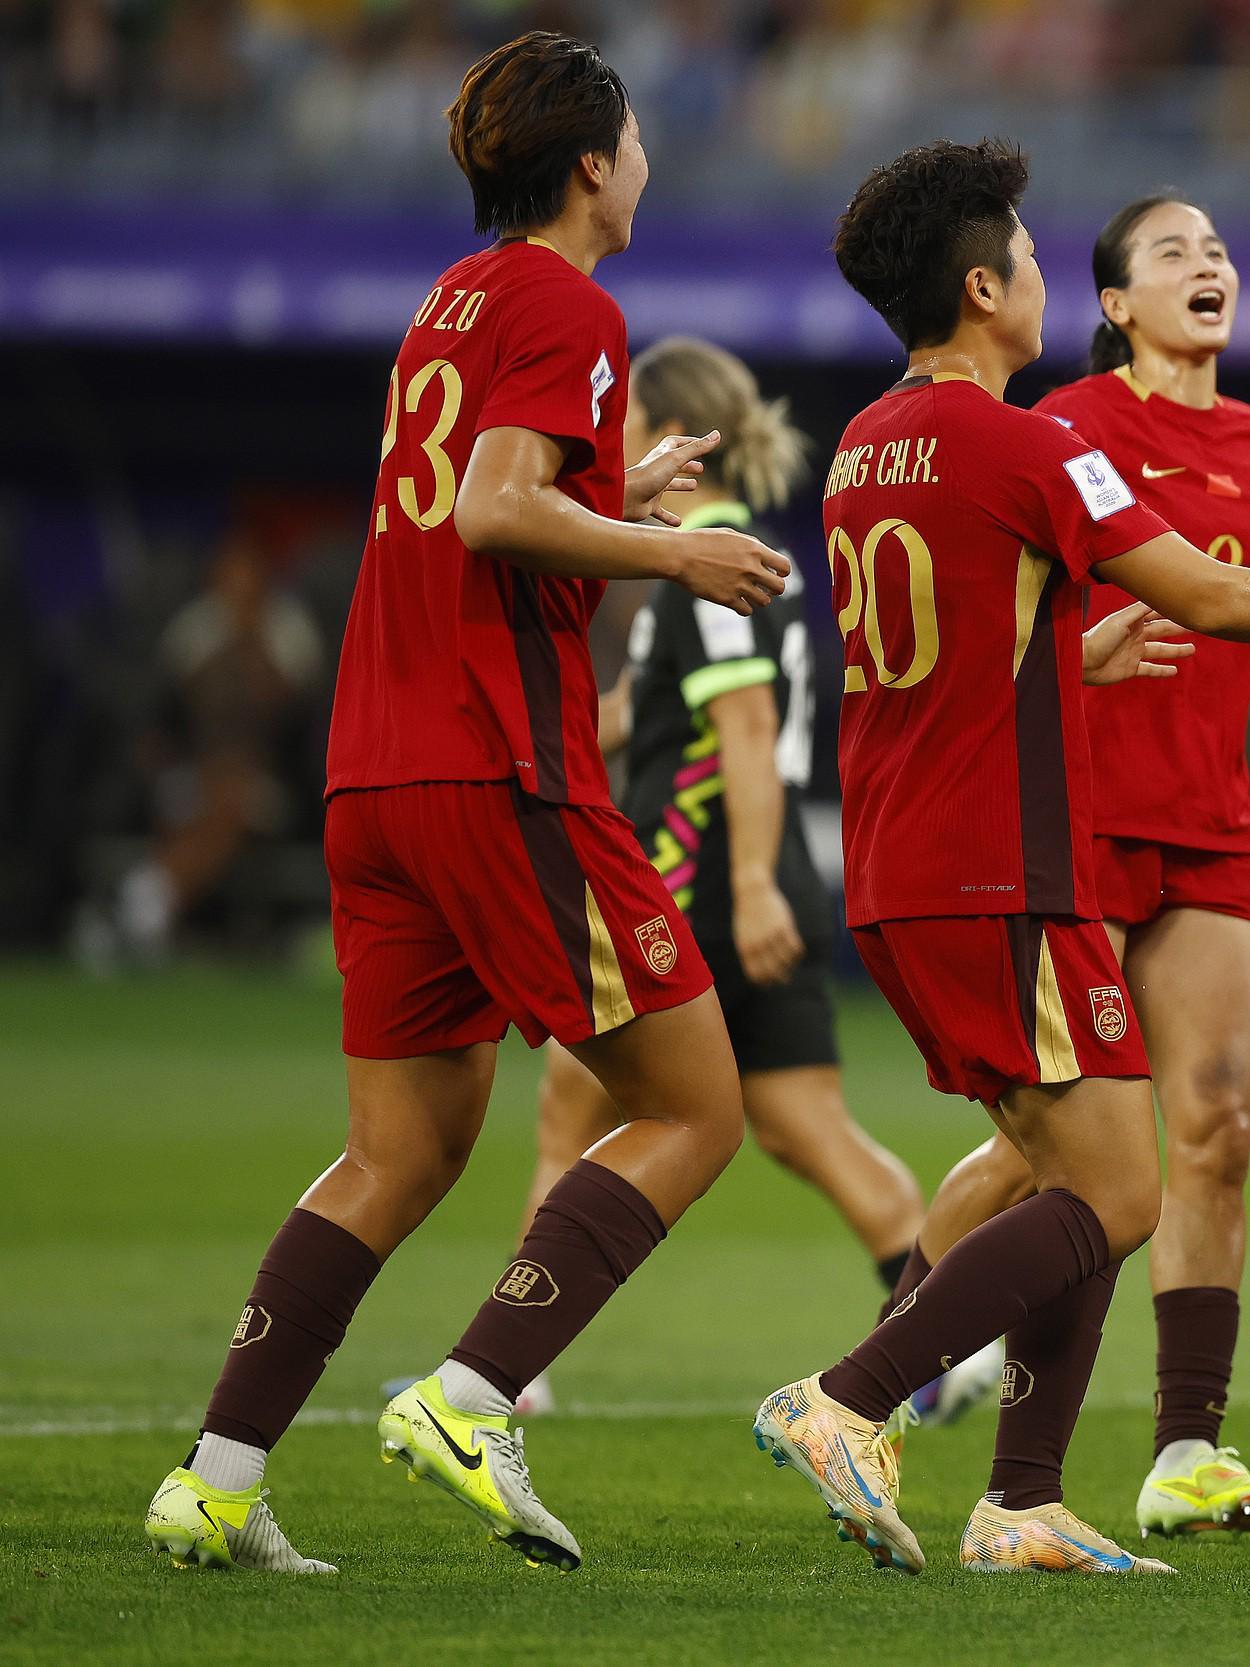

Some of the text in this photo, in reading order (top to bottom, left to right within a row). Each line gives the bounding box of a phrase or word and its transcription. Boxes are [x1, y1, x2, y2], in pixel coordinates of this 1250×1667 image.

[877, 437, 939, 486] CH.X.
[827, 518, 939, 693] 20
[638, 919, 665, 941] CFA
[1092, 989, 1119, 1002] CFA
